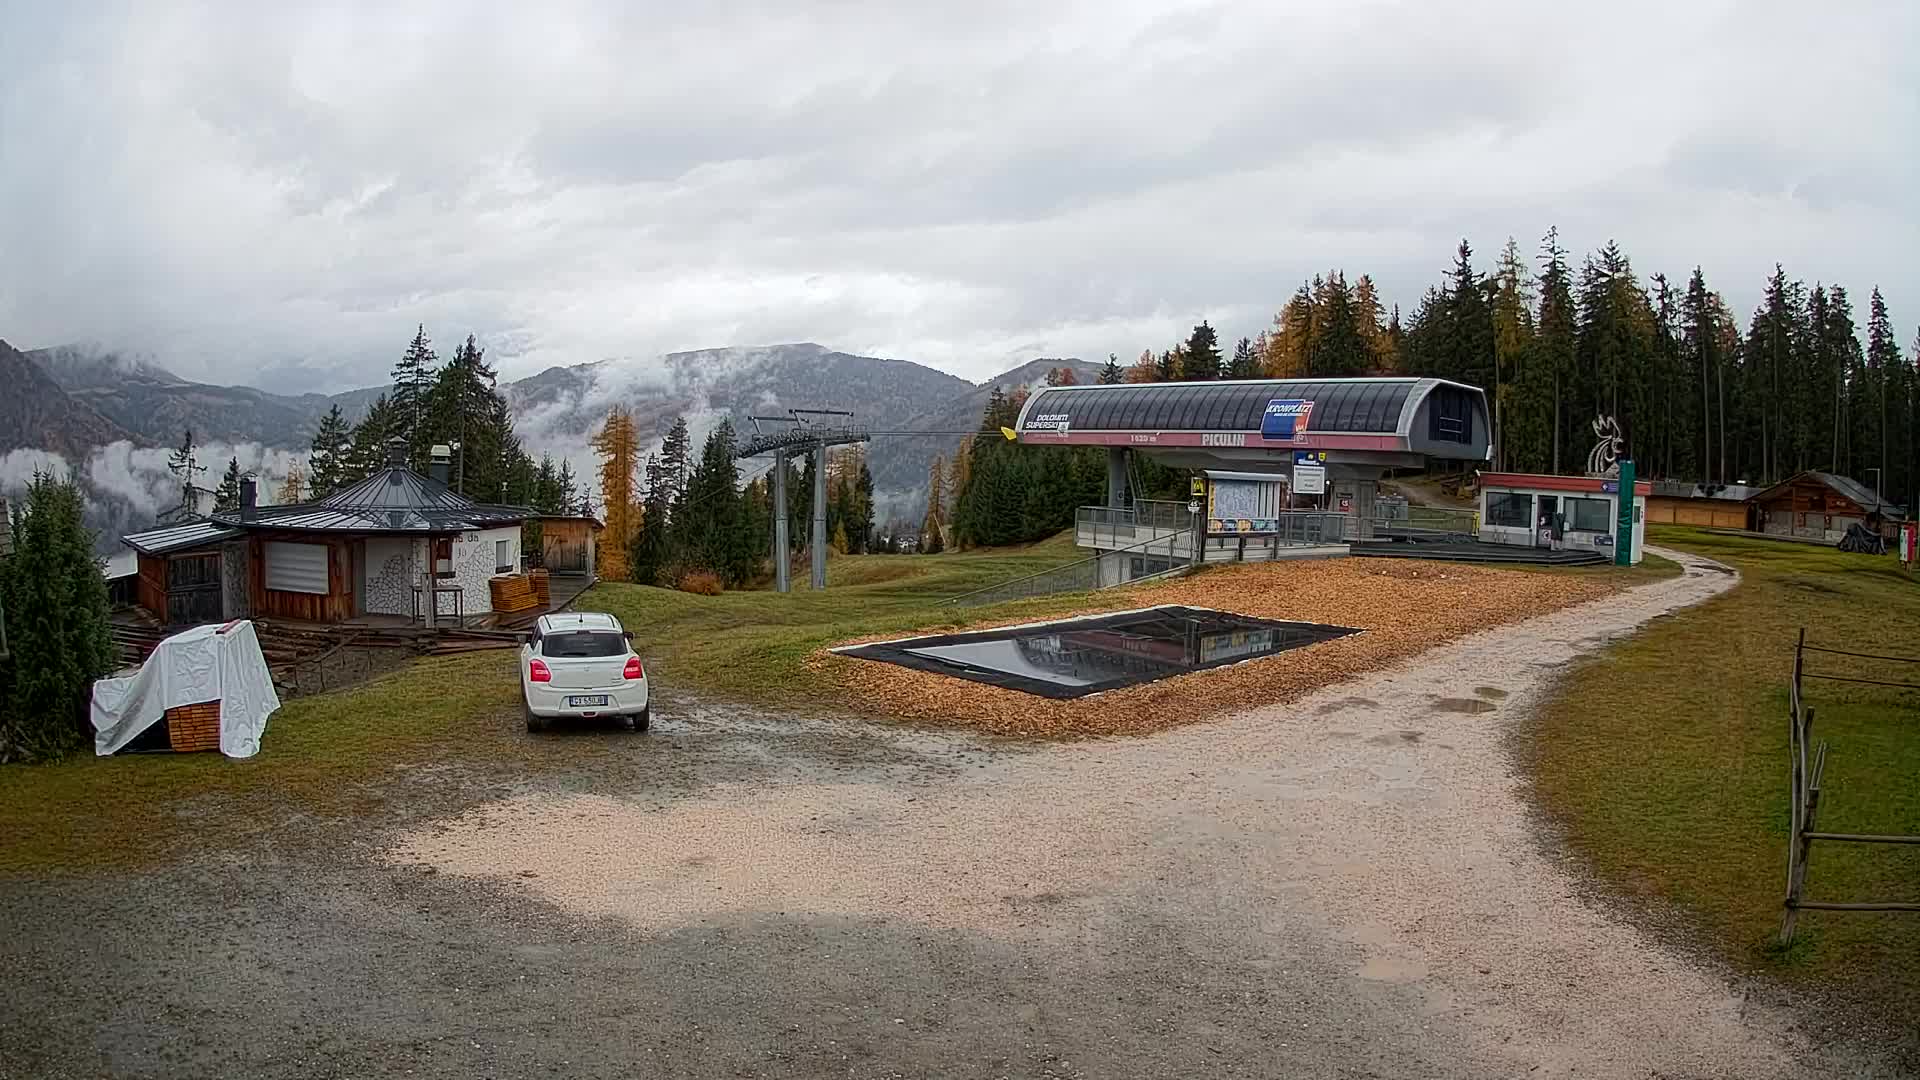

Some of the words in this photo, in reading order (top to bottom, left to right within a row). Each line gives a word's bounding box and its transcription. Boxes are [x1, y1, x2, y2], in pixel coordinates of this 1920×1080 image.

[1265, 404, 1310, 413] KRONPLATZ
[1025, 421, 1059, 429] SUPERSKI
[1202, 433, 1245, 447] PICULIN
